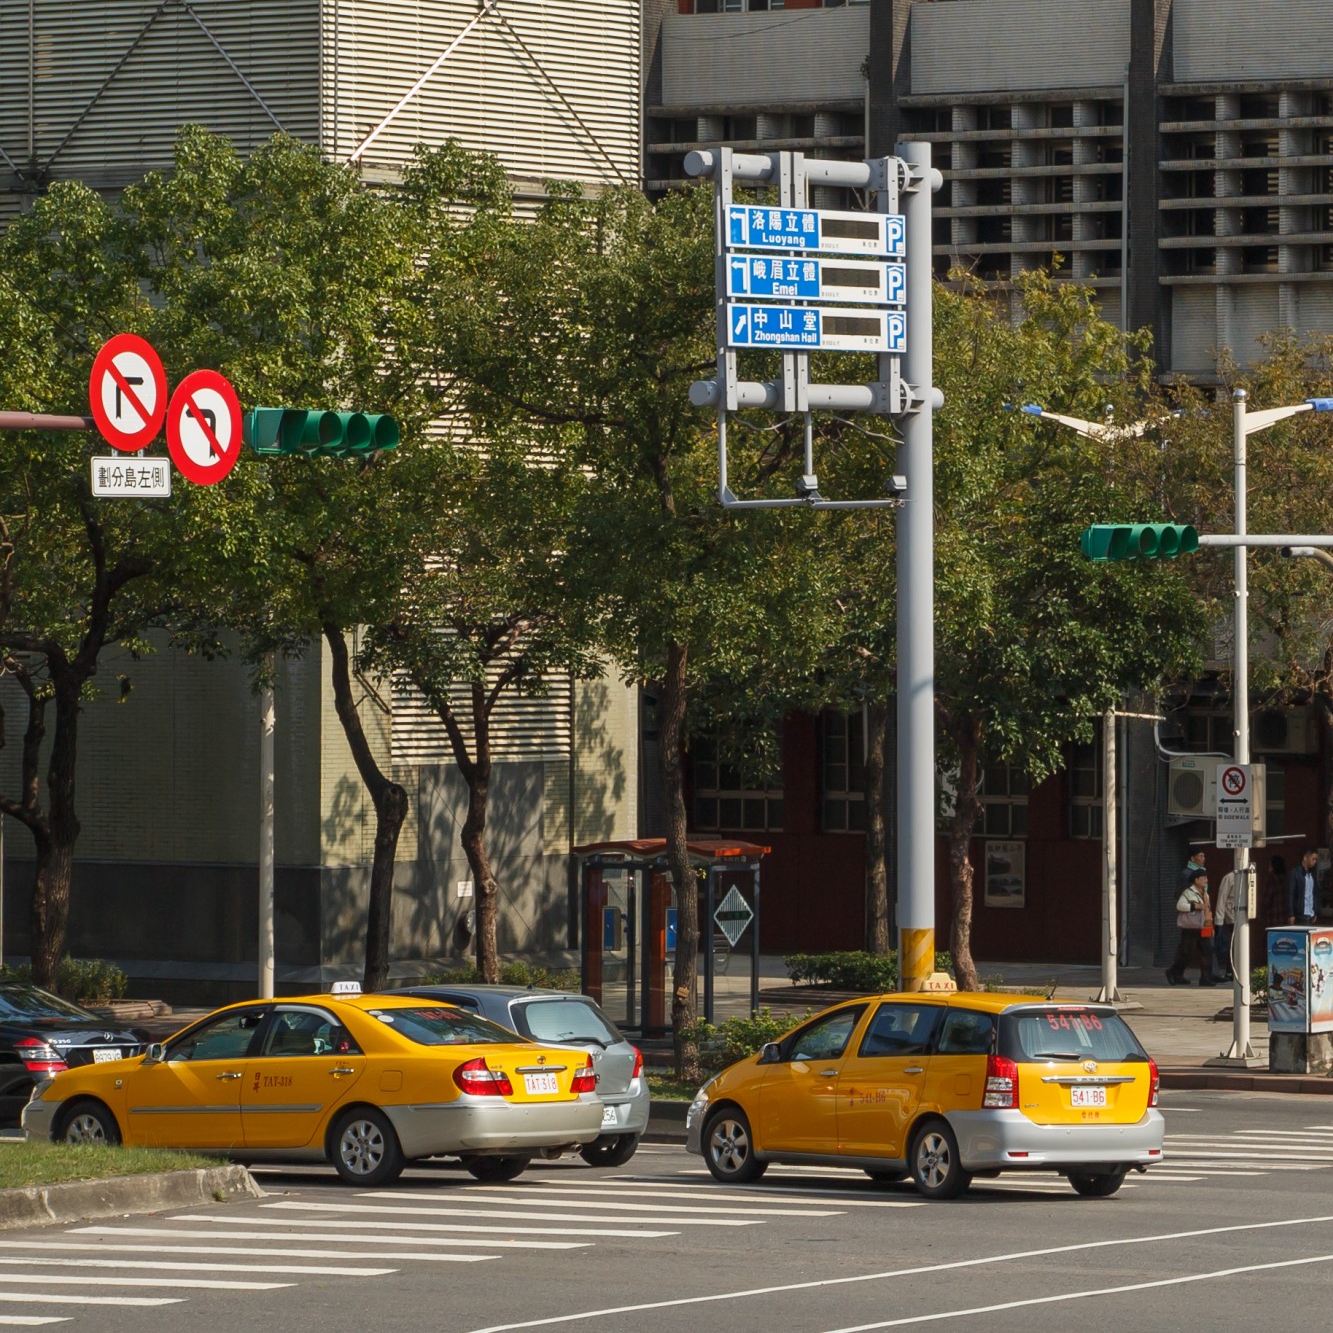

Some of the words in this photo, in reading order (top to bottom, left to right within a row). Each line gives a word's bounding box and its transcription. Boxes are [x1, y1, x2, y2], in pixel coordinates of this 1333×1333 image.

[752, 210, 815, 233] 洛陽立體
[762, 232, 805, 247] Luoyang
[753, 260, 816, 282] 峨眉立體
[772, 282, 798, 296] Emei
[754, 308, 817, 331] 中山堂
[754, 330, 800, 344] Zhongshan
[801, 332, 817, 344] Hall
[98, 466, 164, 488] 劃分島左側
[264, 1076, 293, 1087] TAT-318
